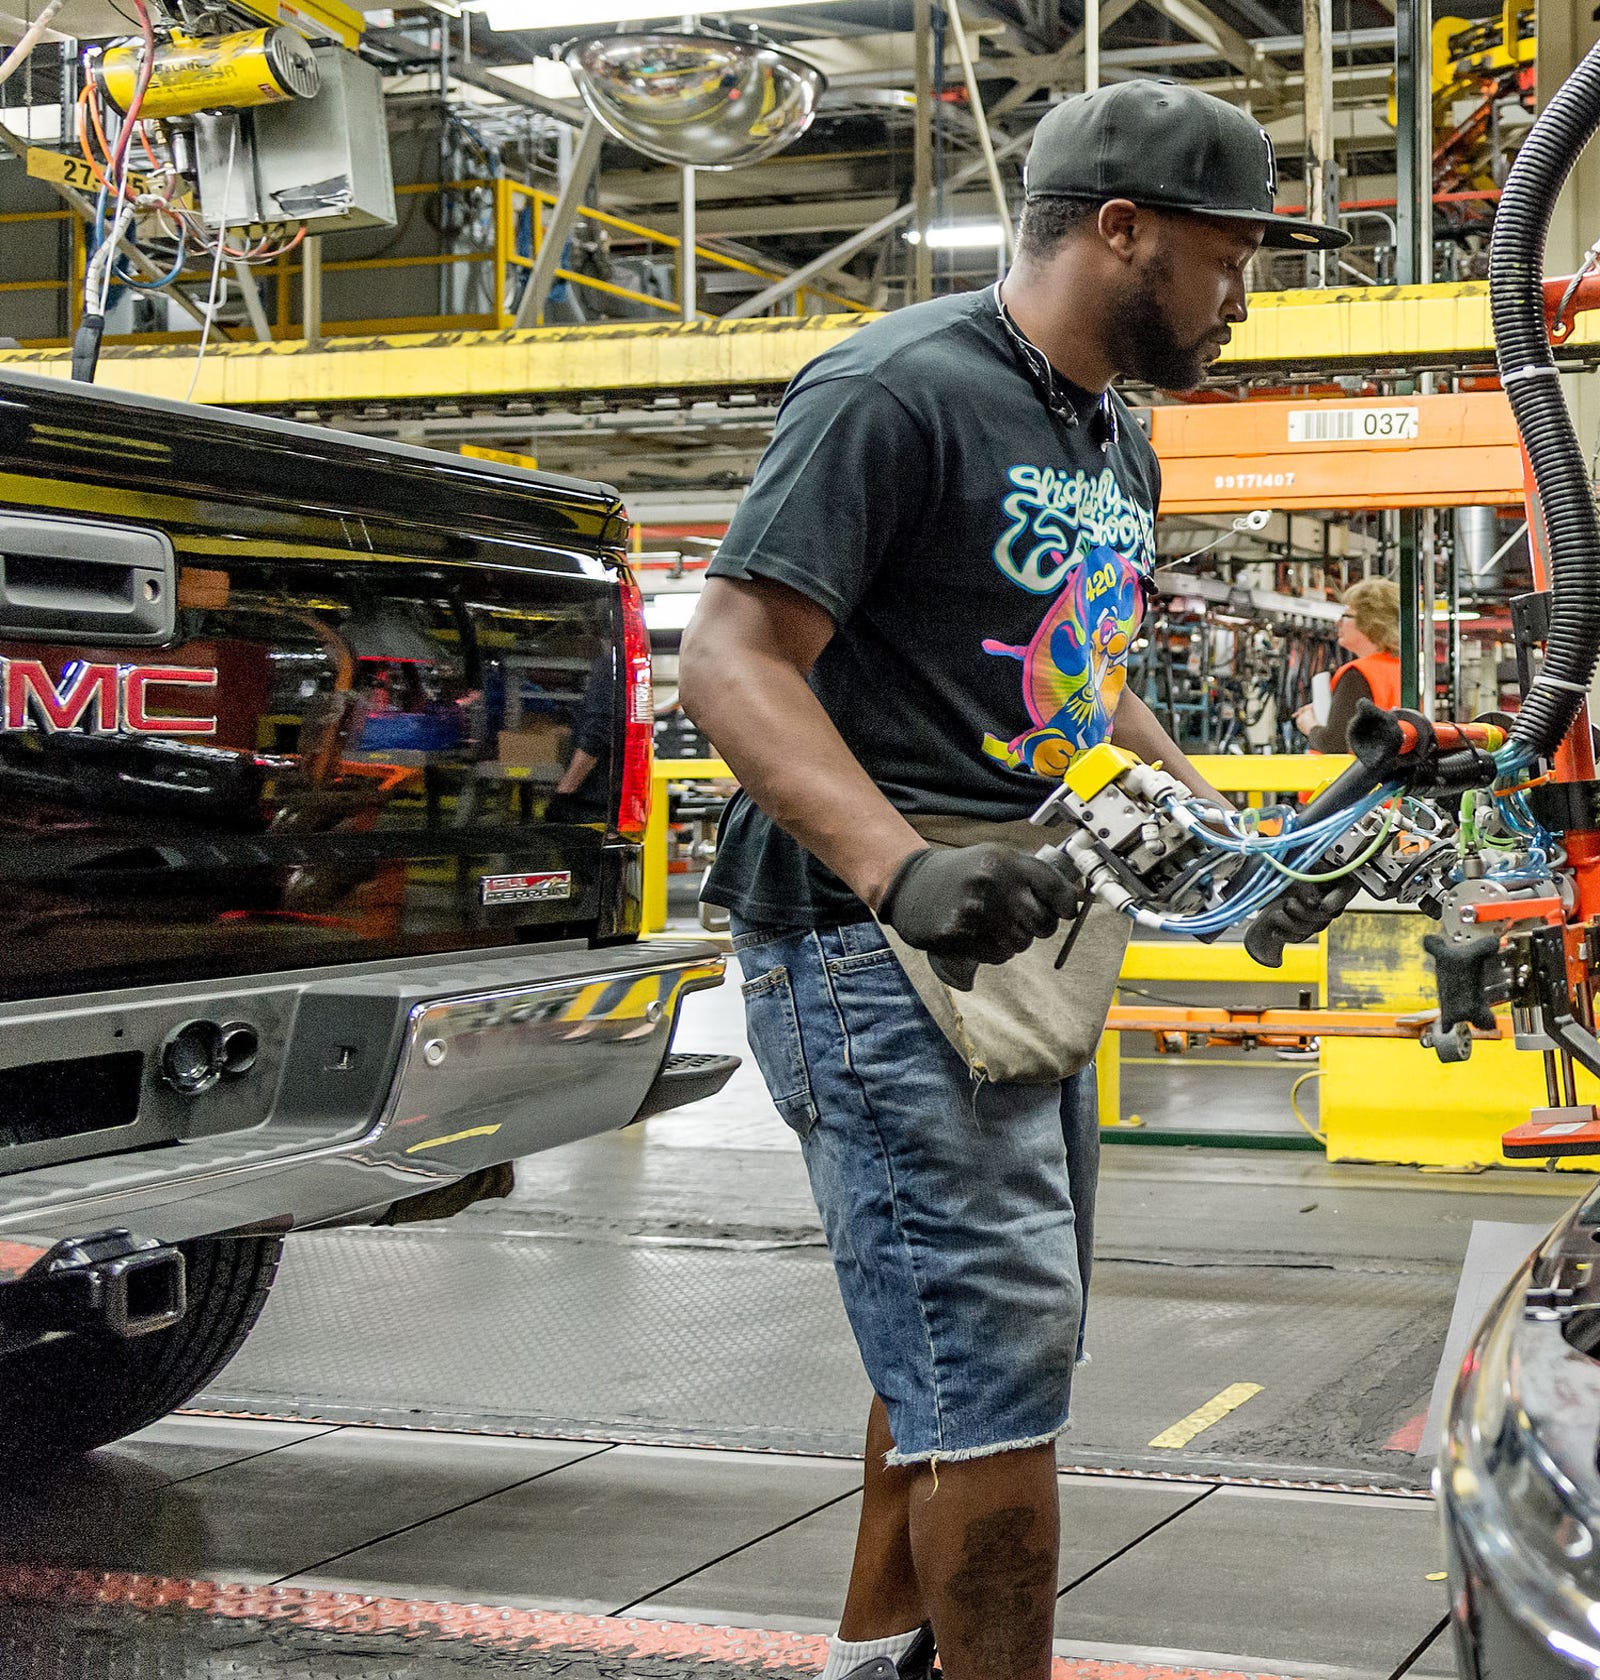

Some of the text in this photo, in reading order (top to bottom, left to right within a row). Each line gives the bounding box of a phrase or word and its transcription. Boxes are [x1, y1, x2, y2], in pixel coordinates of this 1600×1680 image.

[1364, 413, 1409, 435] 037
[1086, 562, 1117, 602] 420
[0, 657, 218, 735] MC
